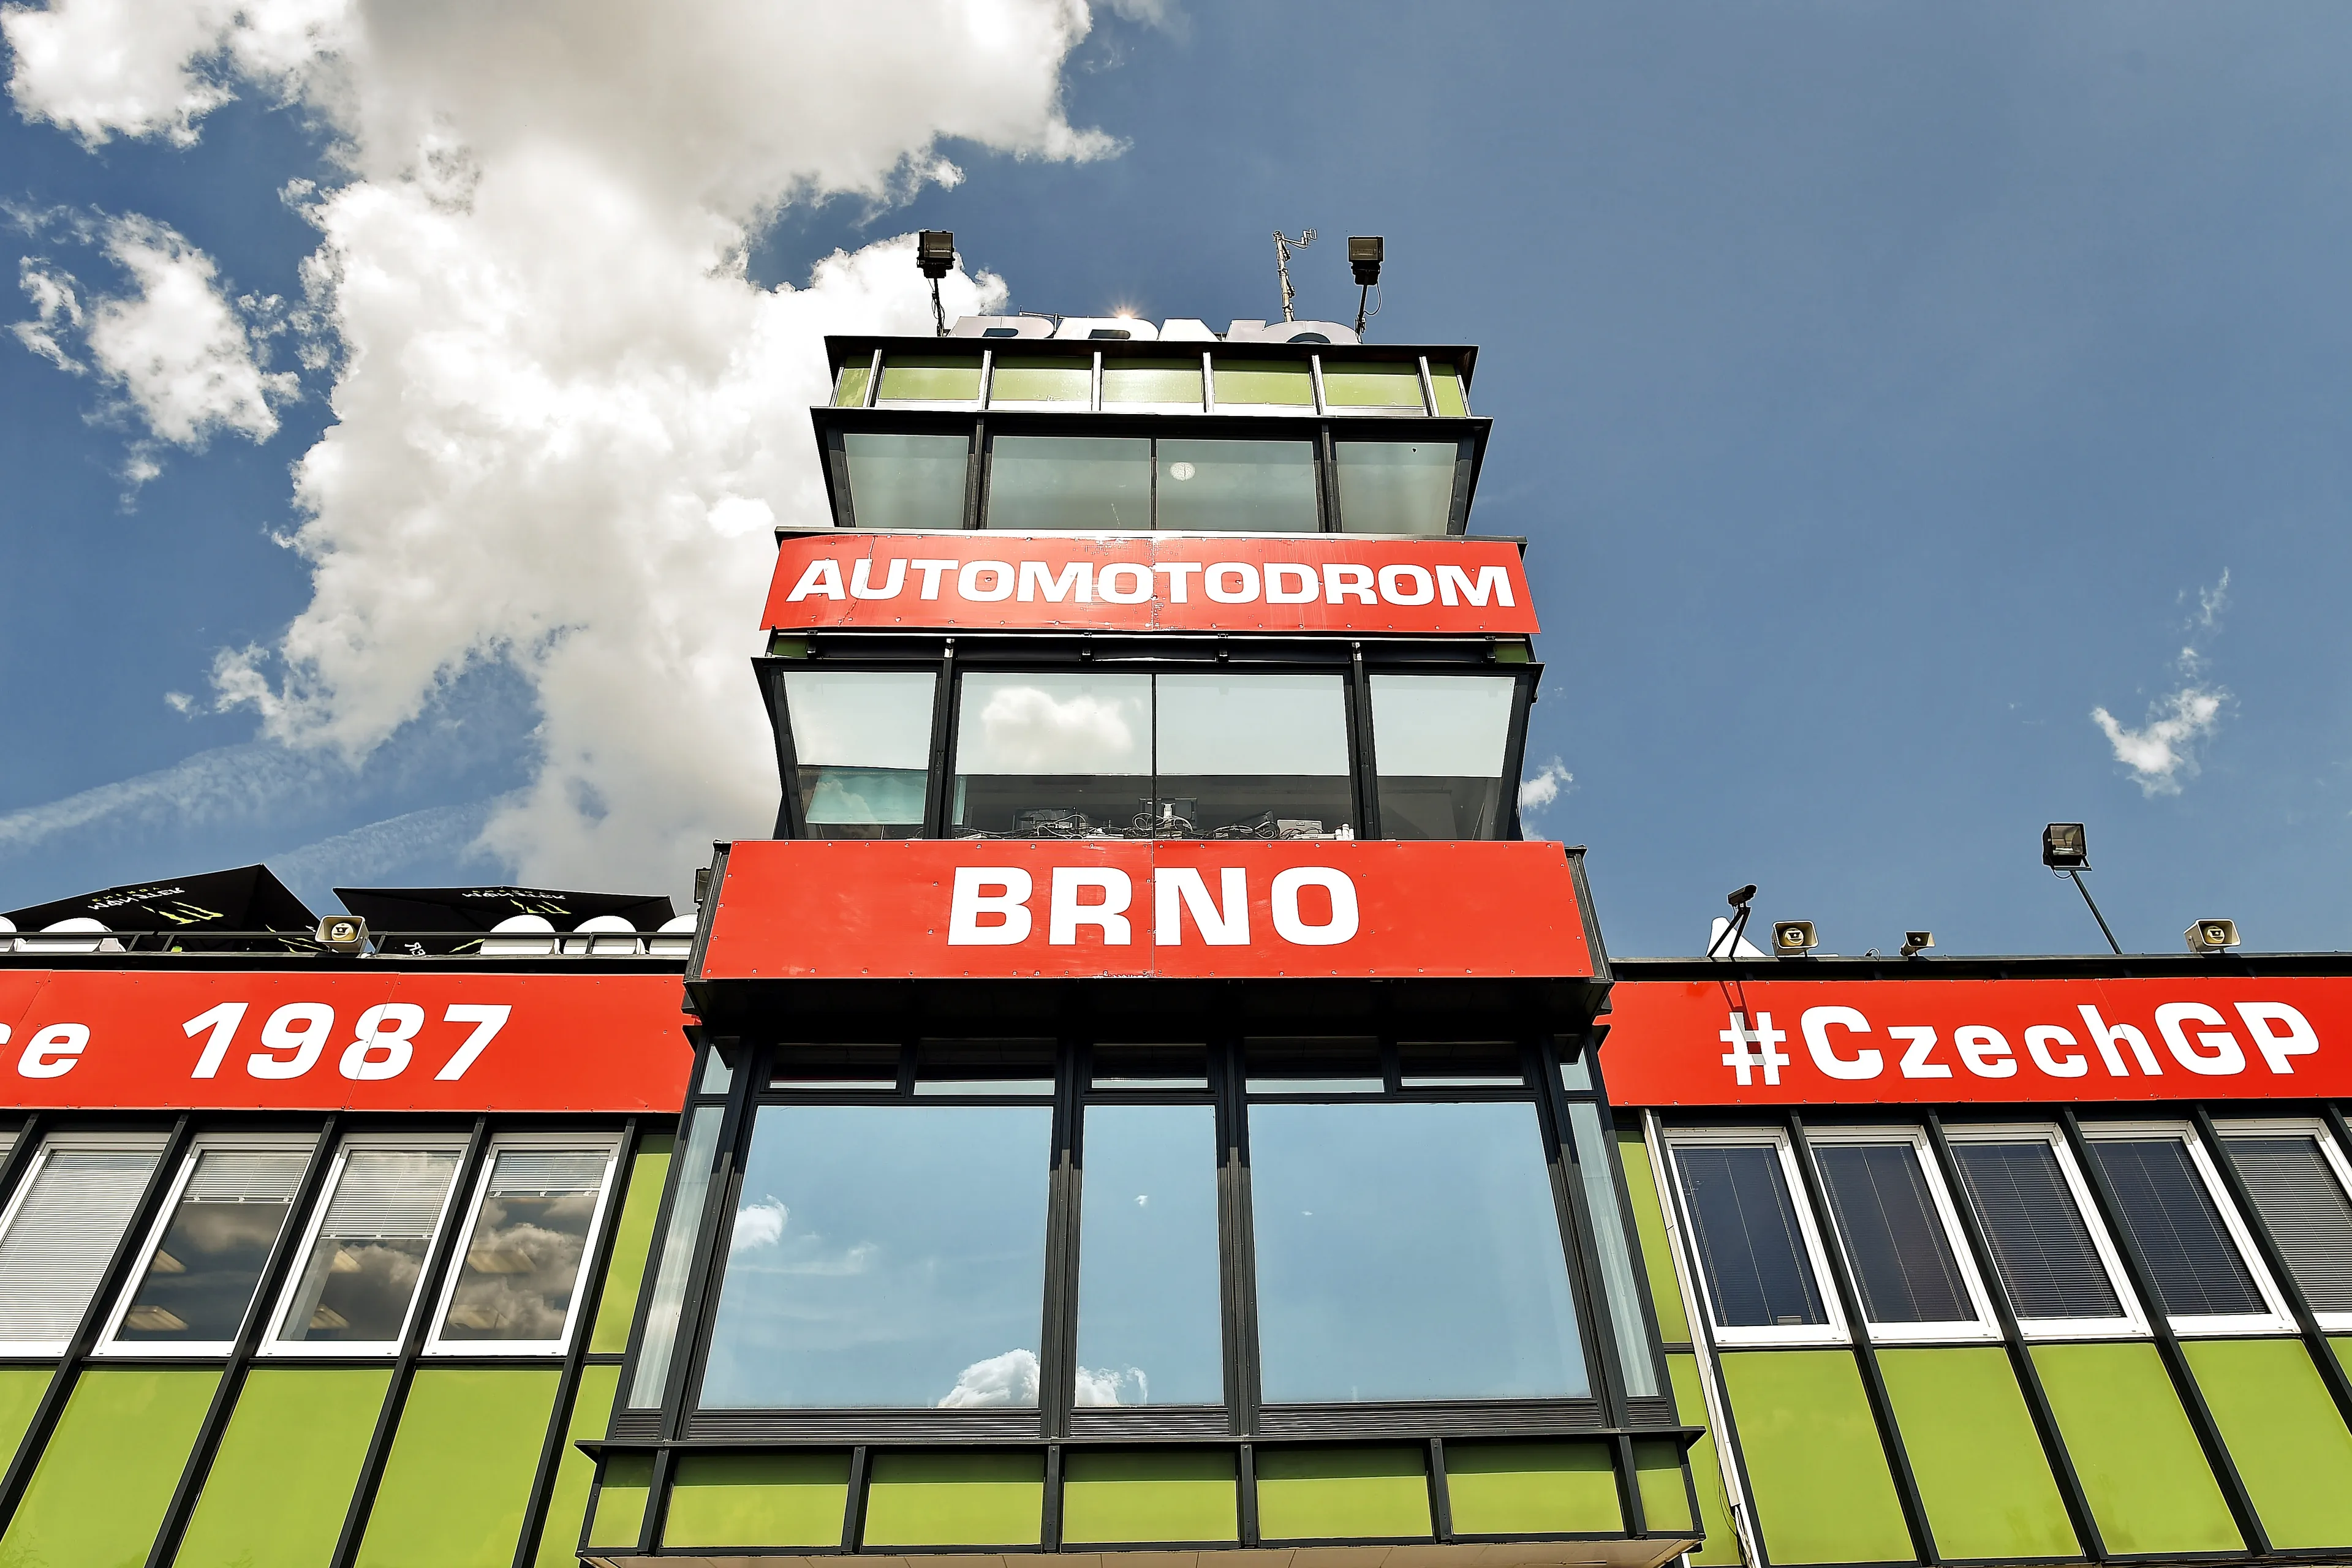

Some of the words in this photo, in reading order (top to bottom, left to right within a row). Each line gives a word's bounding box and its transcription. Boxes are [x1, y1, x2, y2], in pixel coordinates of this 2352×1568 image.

[785, 557, 1516, 608] AUTOMOTODROM
[947, 865, 1360, 947] BRNO
[0, 1022, 91, 1079] e
[181, 1001, 513, 1081] 1987
[1719, 1001, 2320, 1086] #CzechGP
